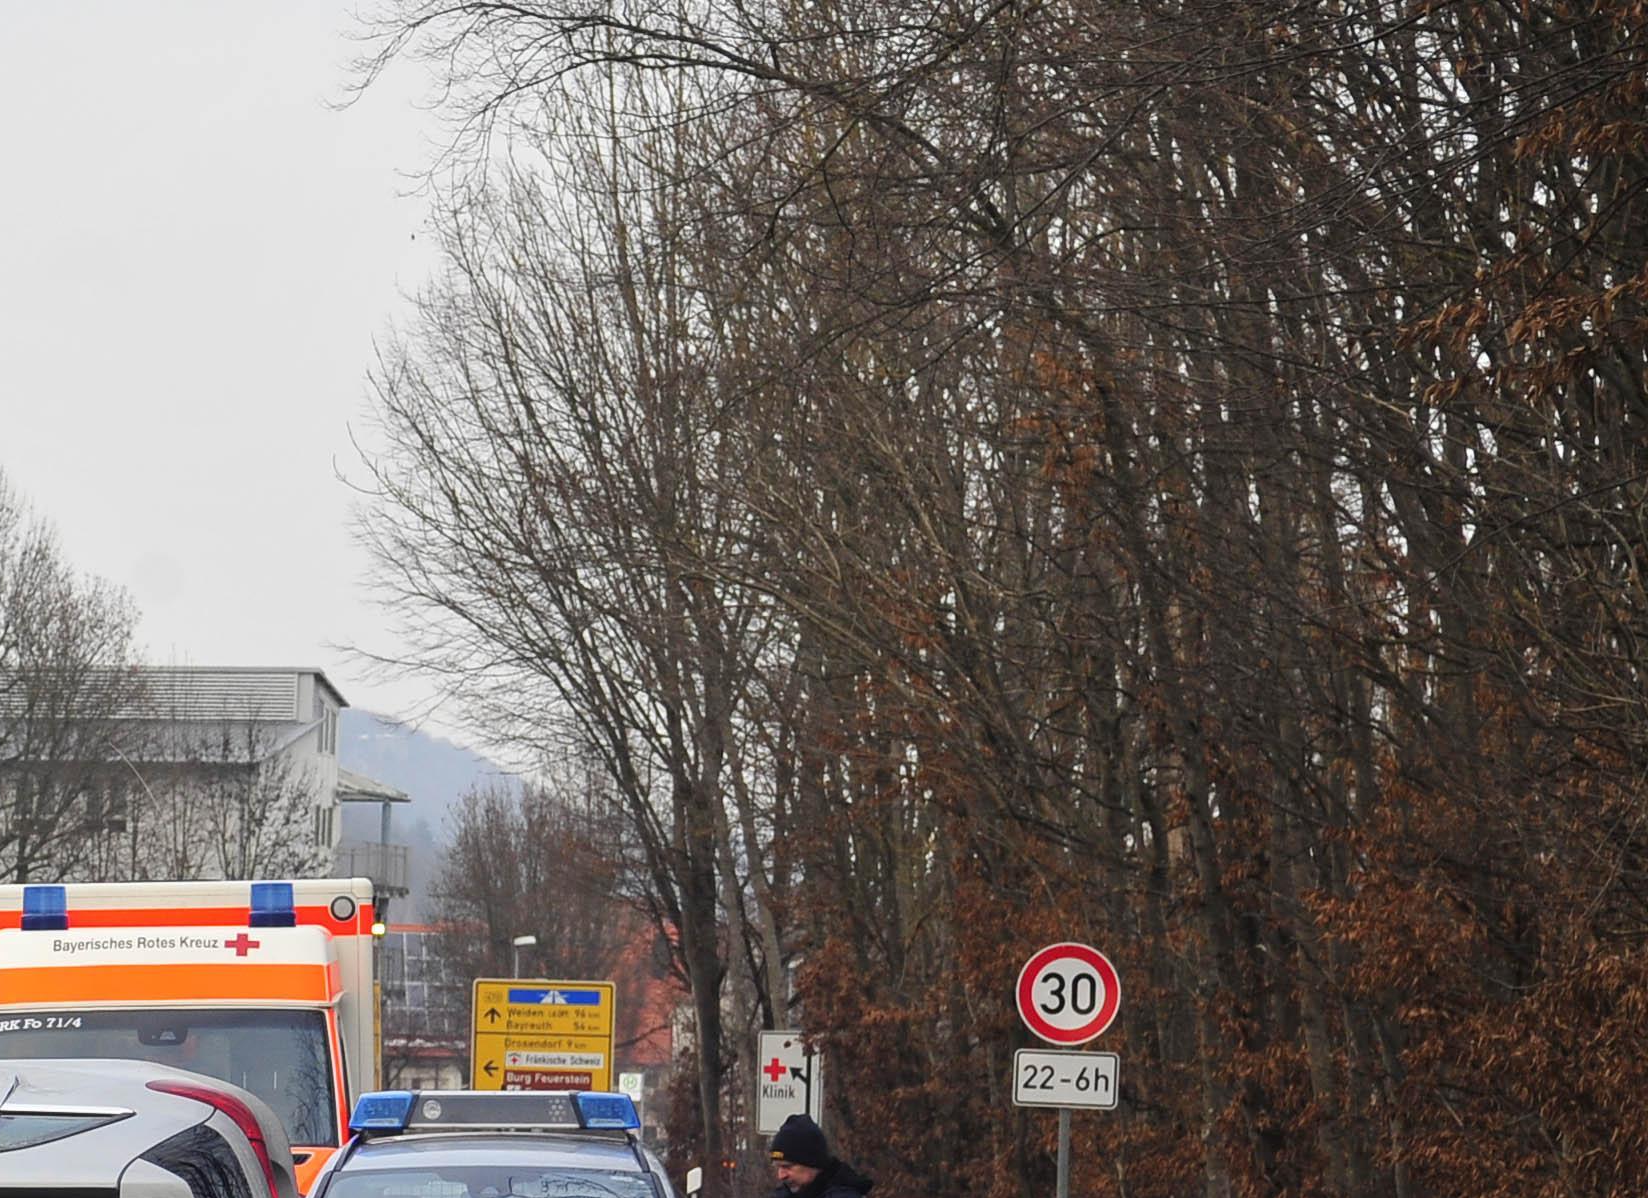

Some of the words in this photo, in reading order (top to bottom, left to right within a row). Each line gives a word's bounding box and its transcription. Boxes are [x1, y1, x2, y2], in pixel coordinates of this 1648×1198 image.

[53, 937, 133, 954] Bayerisches
[137, 936, 176, 949] Rotes
[180, 936, 219, 949] Kreuz
[1040, 972, 1096, 1015] 30
[508, 1007, 544, 1018] Weiden
[22, 1018, 42, 1030] Fo
[46, 1016, 82, 1029] 71/4
[506, 1020, 552, 1031] Bayreuth
[525, 1053, 566, 1065] Fränkische
[570, 1054, 601, 1066] Schweiz
[506, 1072, 532, 1084] Burg
[534, 1073, 591, 1084] Feuerstein
[762, 1084, 795, 1099] Klinik
